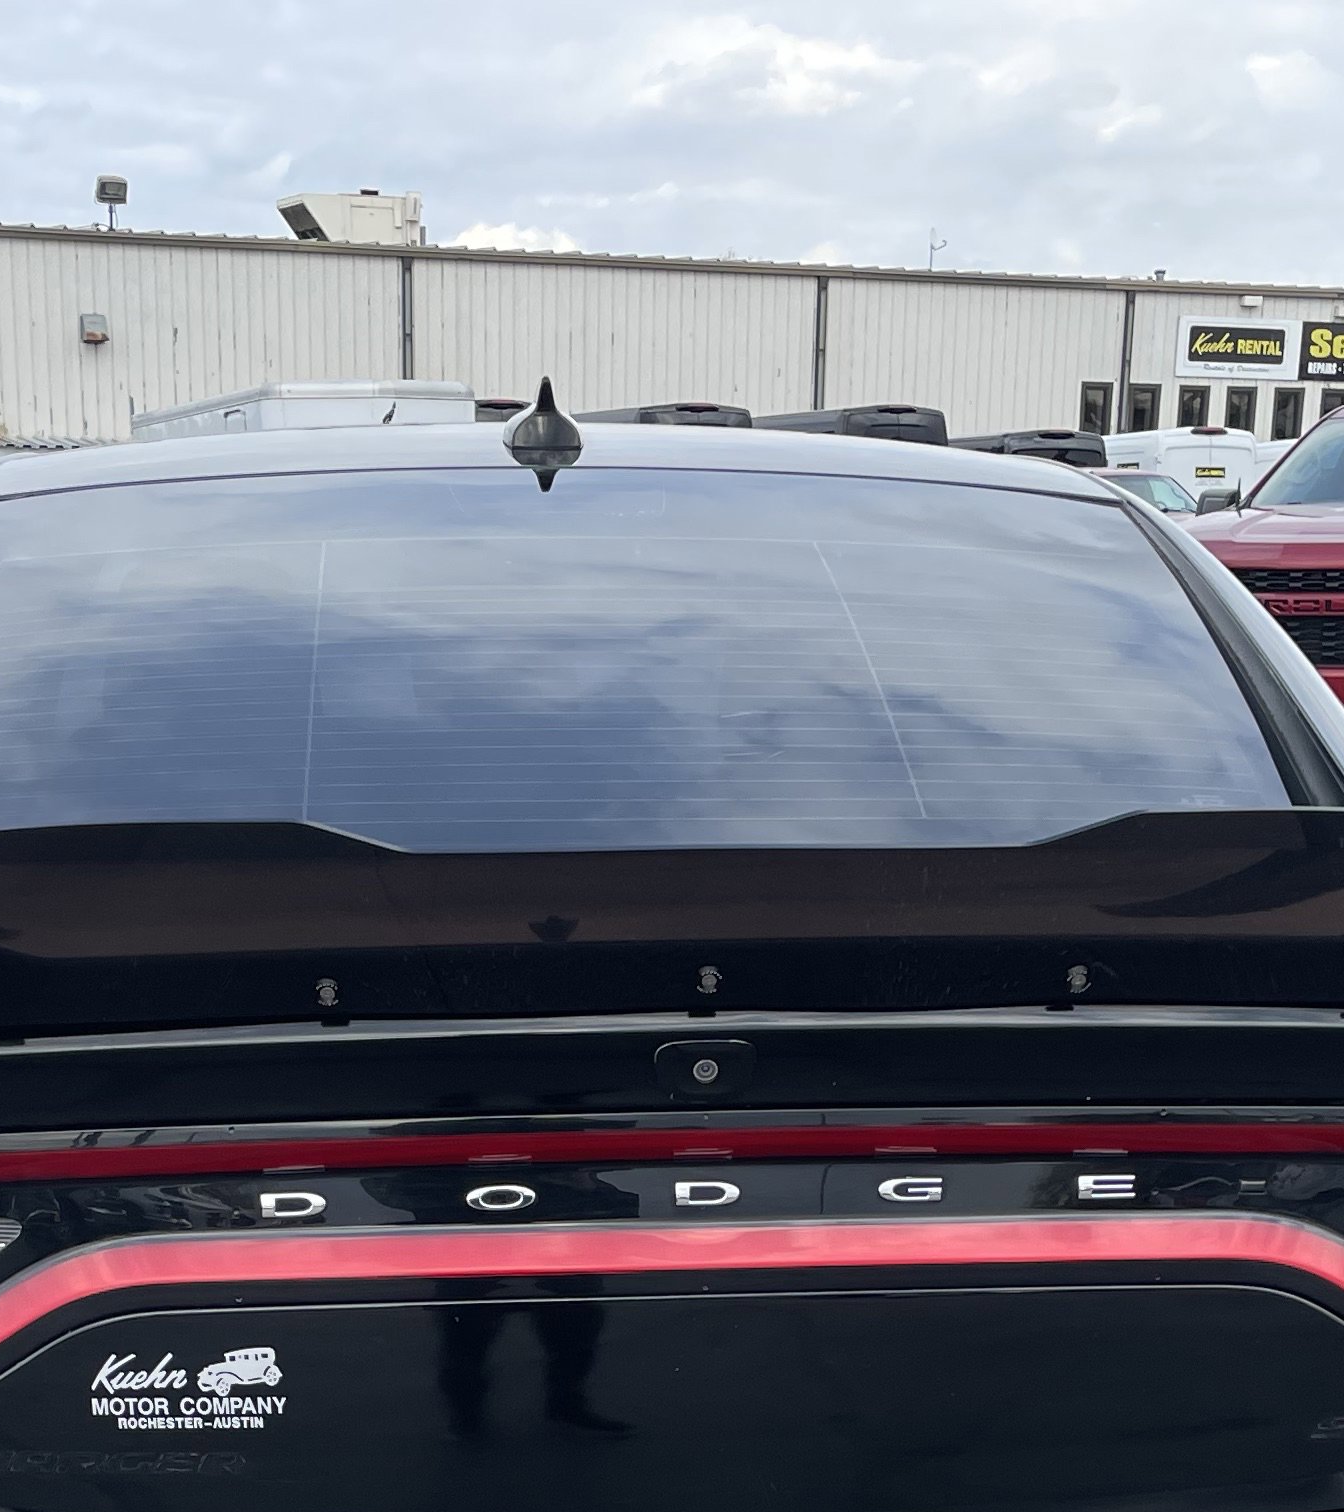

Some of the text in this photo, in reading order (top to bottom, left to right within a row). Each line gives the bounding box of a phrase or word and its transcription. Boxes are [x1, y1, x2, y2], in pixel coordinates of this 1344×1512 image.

[1191, 333, 1282, 356] Kuehn RENTAL
[1307, 362, 1337, 375] REPAIRS
[260, 1174, 1137, 1220] DODGE
[91, 1353, 188, 1394] Kuehn
[91, 1397, 287, 1416] MOTOR COMPANY
